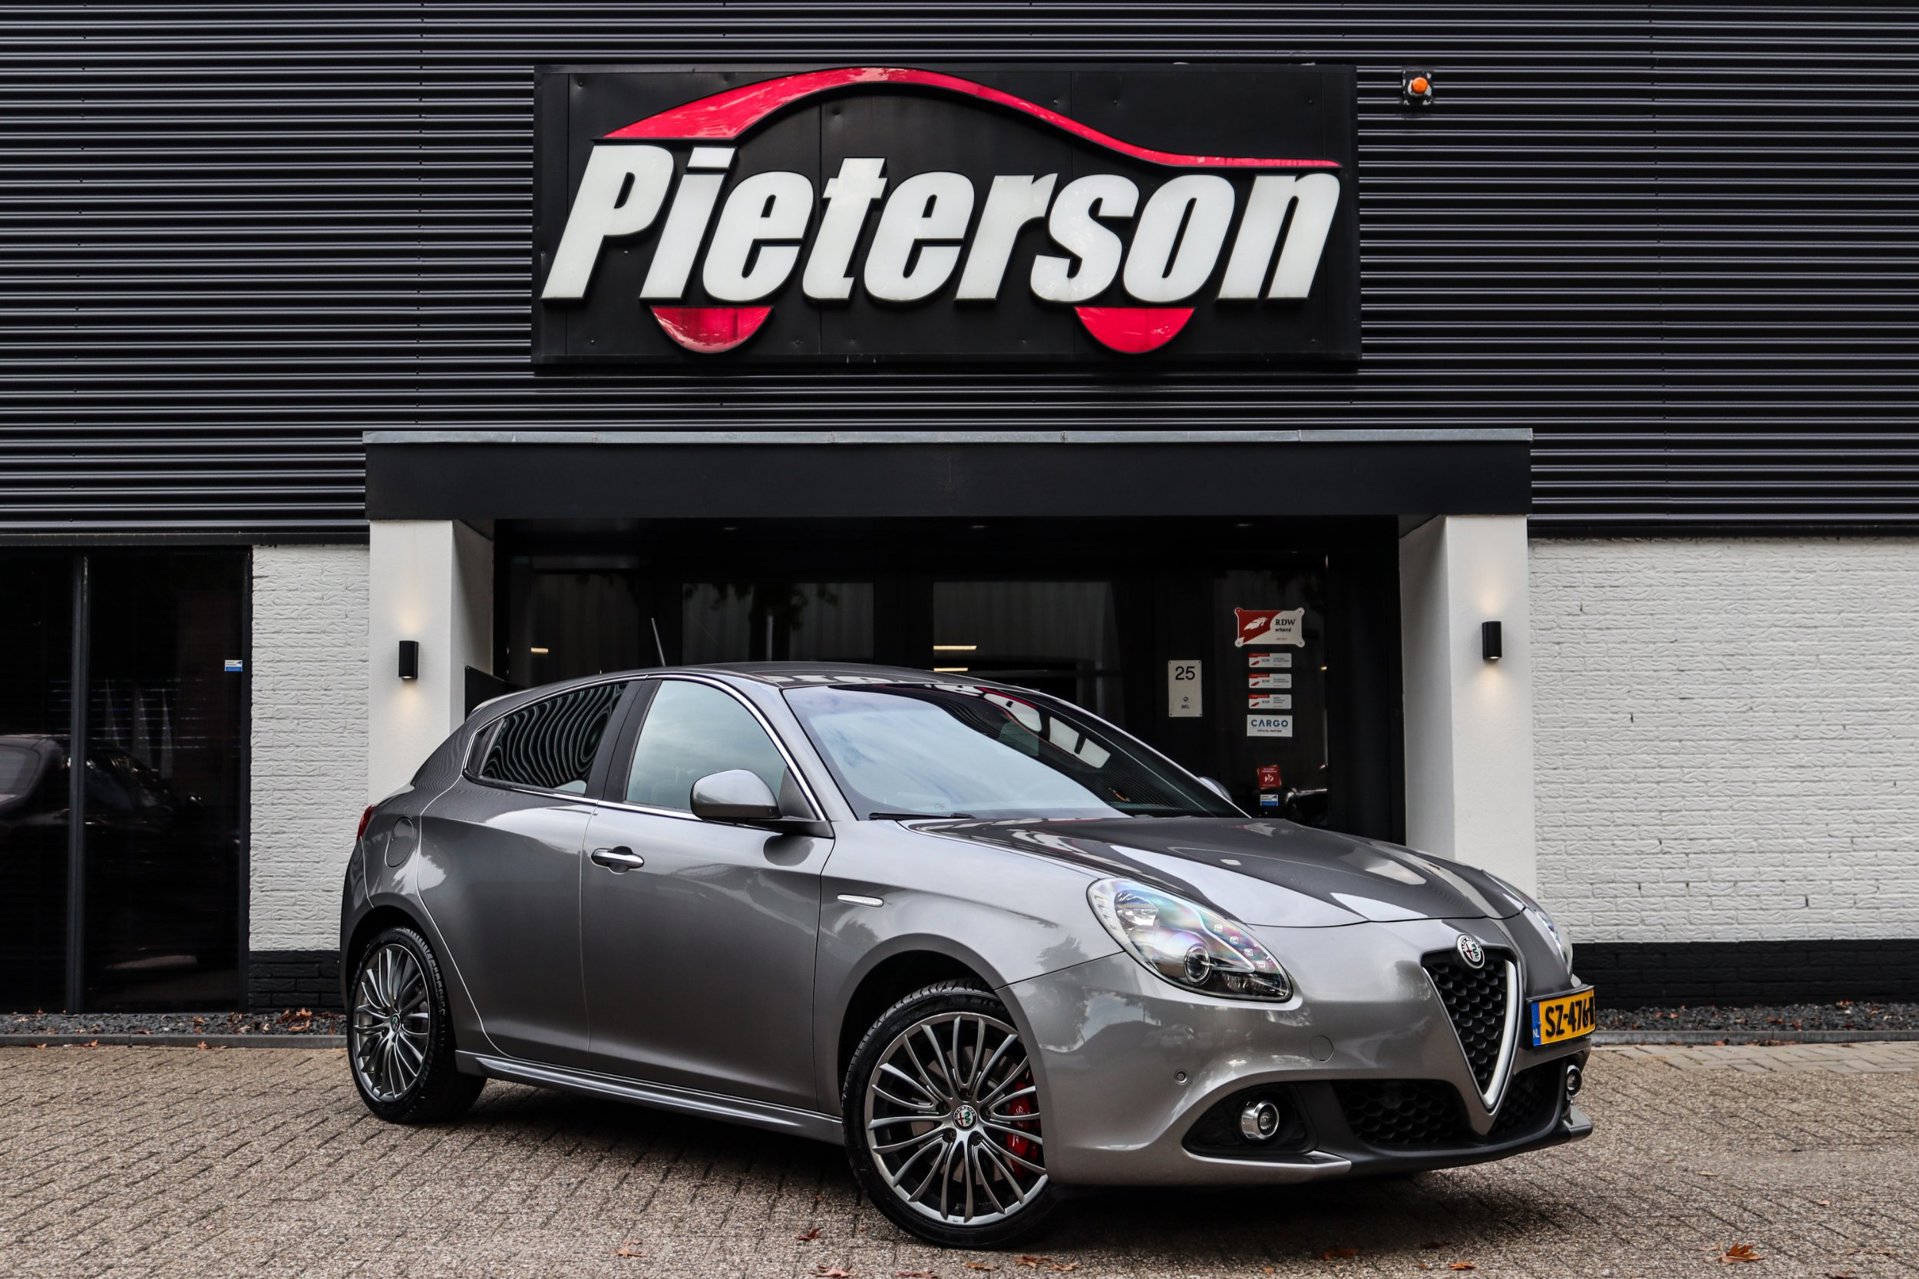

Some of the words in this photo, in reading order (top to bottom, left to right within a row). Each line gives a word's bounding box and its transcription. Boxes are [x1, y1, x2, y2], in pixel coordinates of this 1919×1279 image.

[541, 144, 1341, 302] Pieterson
[1175, 666, 1195, 680] 25
[1250, 719, 1289, 728] CARGO
